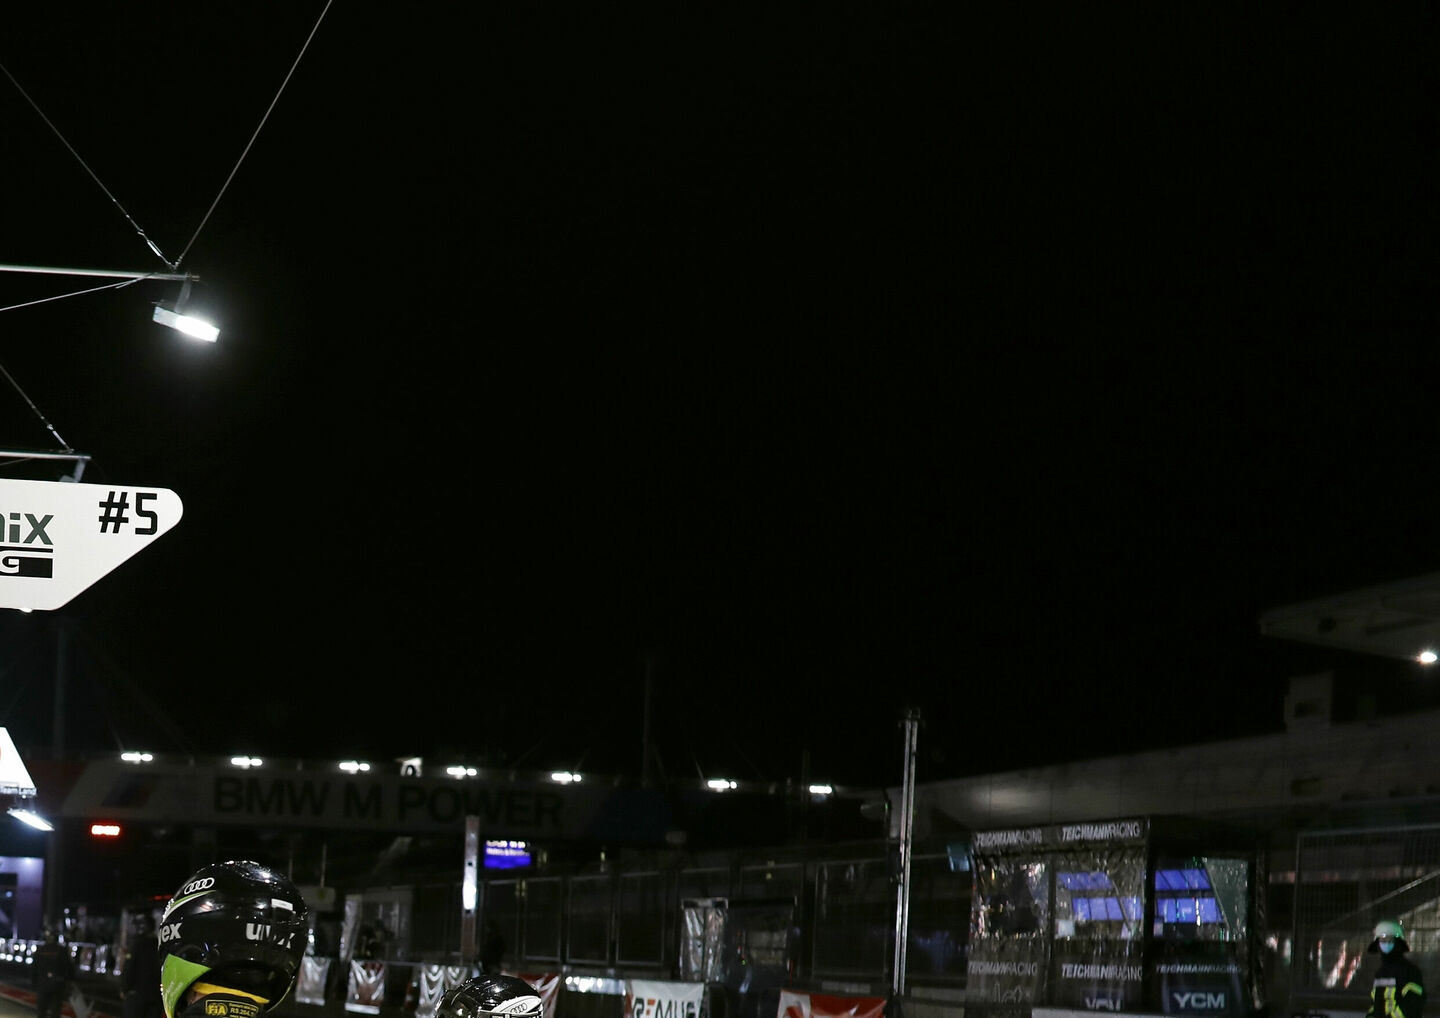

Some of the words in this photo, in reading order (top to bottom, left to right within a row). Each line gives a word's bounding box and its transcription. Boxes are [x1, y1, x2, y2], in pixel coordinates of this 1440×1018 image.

[98, 491, 158, 535] #5
[0, 786, 18, 795] Team
[19, 787, 36, 795] Land
[214, 775, 327, 816] BMW
[344, 781, 386, 818] M
[397, 783, 562, 828] POWER
[1173, 992, 1226, 1009] YCM
